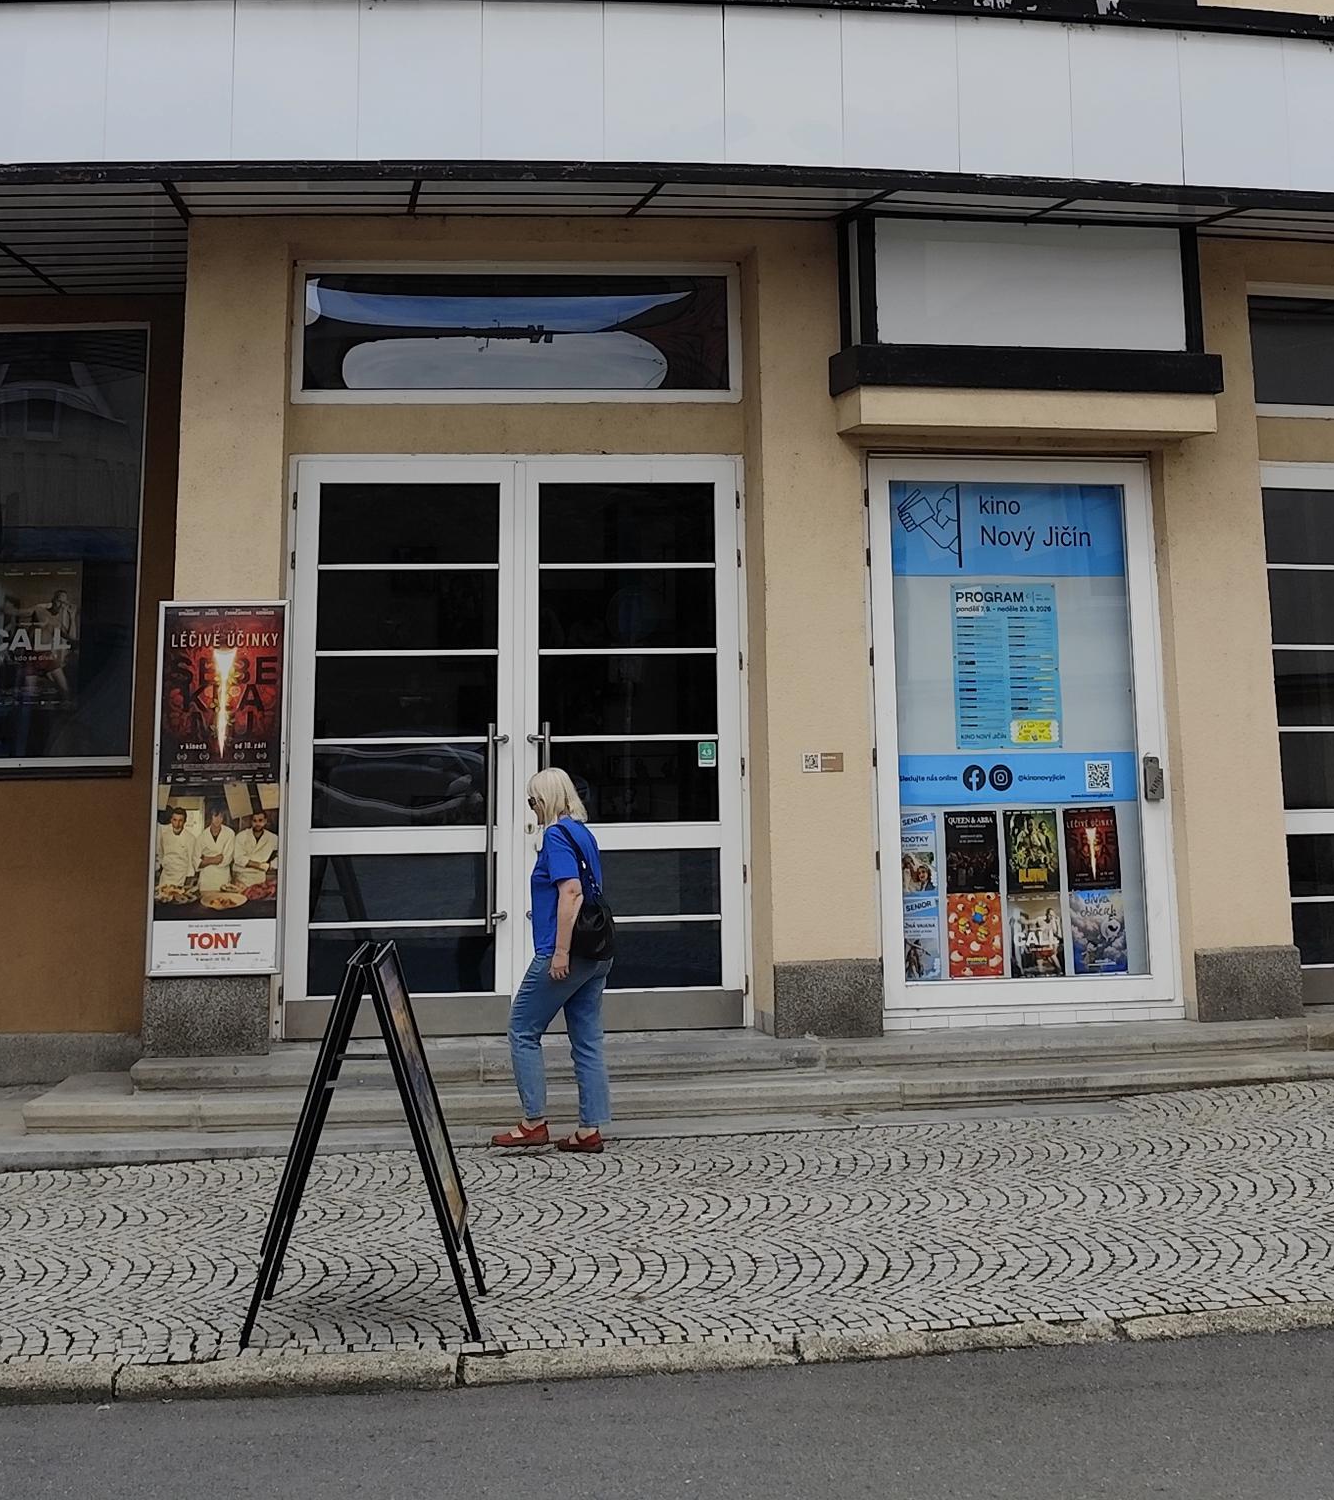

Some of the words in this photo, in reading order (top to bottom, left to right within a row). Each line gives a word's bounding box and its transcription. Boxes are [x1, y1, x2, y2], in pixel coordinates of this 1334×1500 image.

[979, 494, 1021, 515] kino
[980, 525, 1035, 552] Nový
[1043, 525, 1092, 547] Jičín
[955, 591, 1024, 604] PROGRAM
[171, 630, 221, 648] LÉČIVÉ
[227, 630, 279, 648] ÚČINKY
[901, 814, 929, 827] SENIOR
[947, 816, 971, 826] QUEEN
[976, 816, 994, 825] ABBA
[905, 900, 932, 912] SENIOR
[187, 932, 242, 950] TONY
